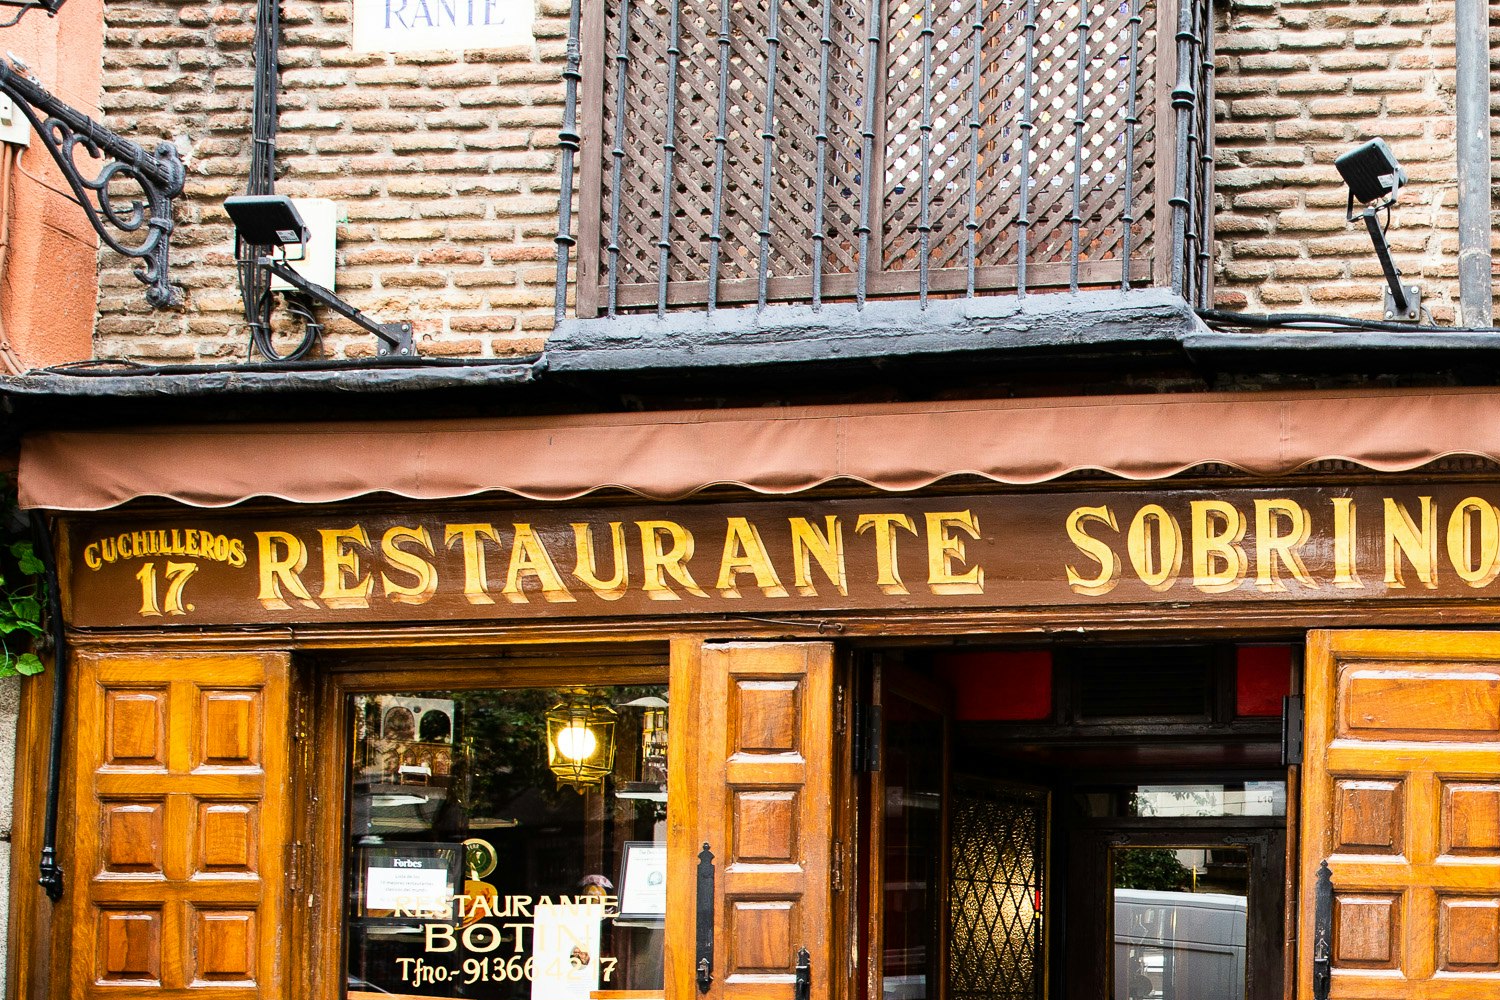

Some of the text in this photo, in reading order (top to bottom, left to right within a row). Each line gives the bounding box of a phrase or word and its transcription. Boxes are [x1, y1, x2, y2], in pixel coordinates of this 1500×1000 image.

[83, 528, 248, 571] CUCHILLEROS
[254, 509, 987, 612] RESTAURANTE
[393, 858, 422, 868] Forbes
[394, 894, 621, 918] RESTAURANTE
[424, 922, 591, 953] BOTIN
